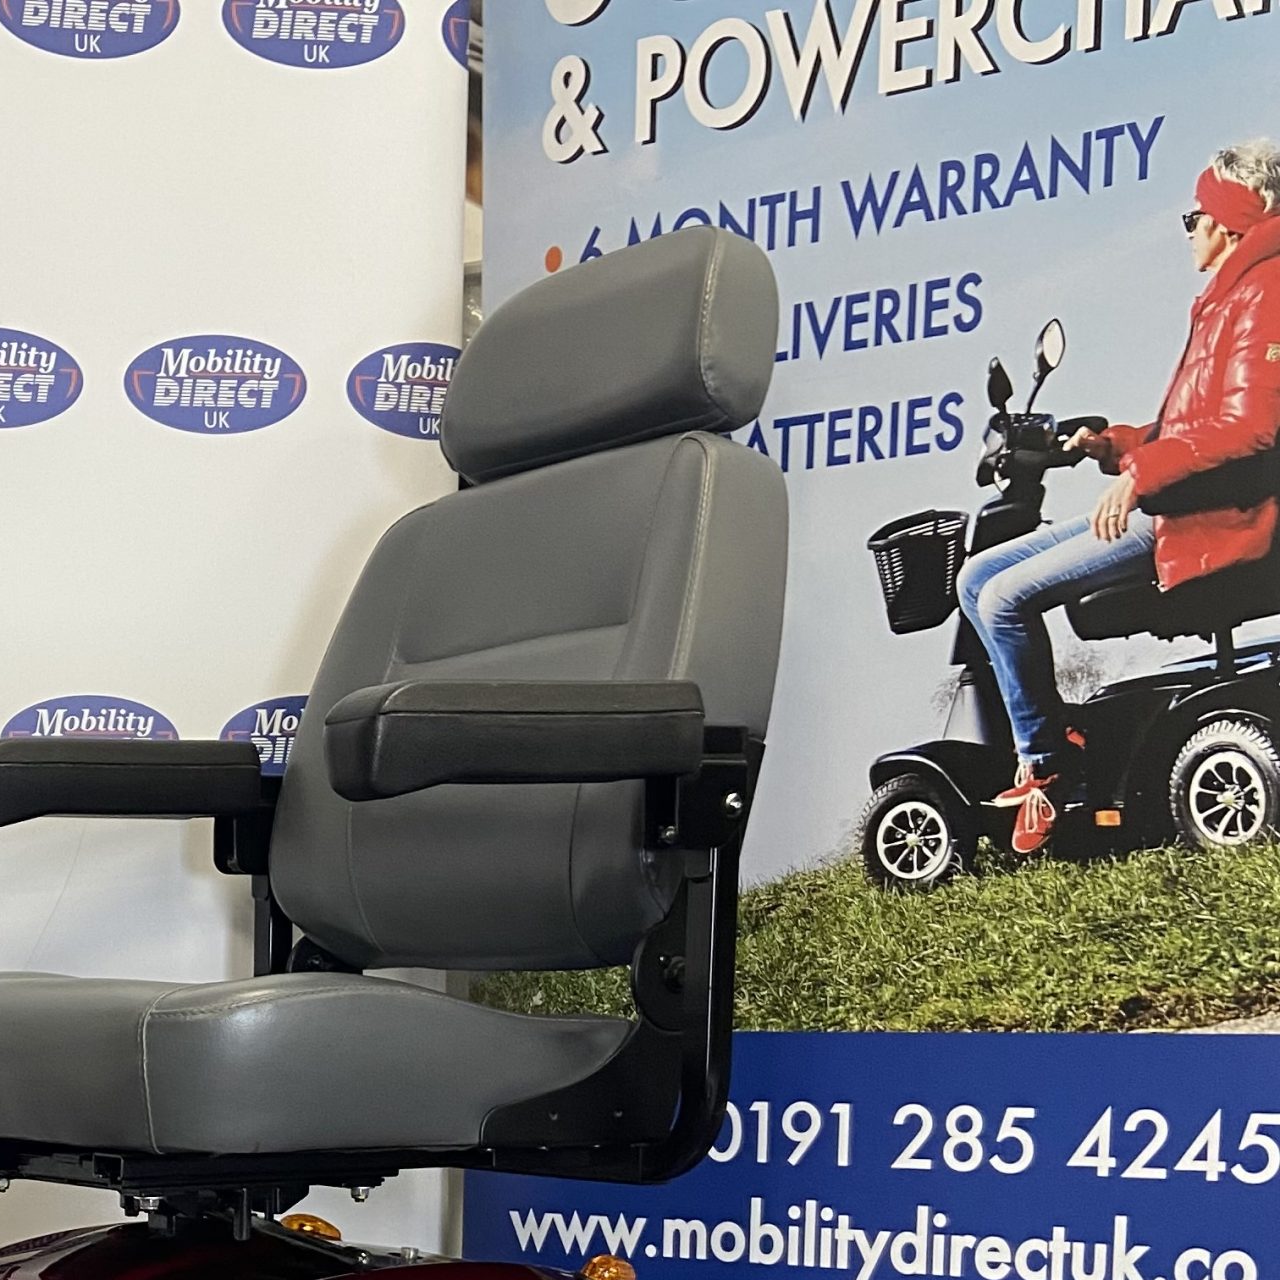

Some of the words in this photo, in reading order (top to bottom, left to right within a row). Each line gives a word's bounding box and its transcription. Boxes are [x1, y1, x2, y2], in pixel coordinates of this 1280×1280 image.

[21, 0, 152, 34] DIRECT
[252, 9, 380, 44] DIRECT
[74, 33, 102, 53] UK
[303, 44, 330, 63] UK
[541, 54, 609, 165] &
[840, 115, 1166, 241] WARRANTY
[774, 272, 984, 363] IVERIES
[156, 347, 283, 381] Mobility
[153, 377, 280, 409] DIRECT
[204, 410, 231, 430] UK
[721, 391, 965, 474] ATTERIES
[32, 708, 154, 738] Mobility
[891, 1104, 1036, 1176] 285
[1066, 1105, 1280, 1185] 4245
